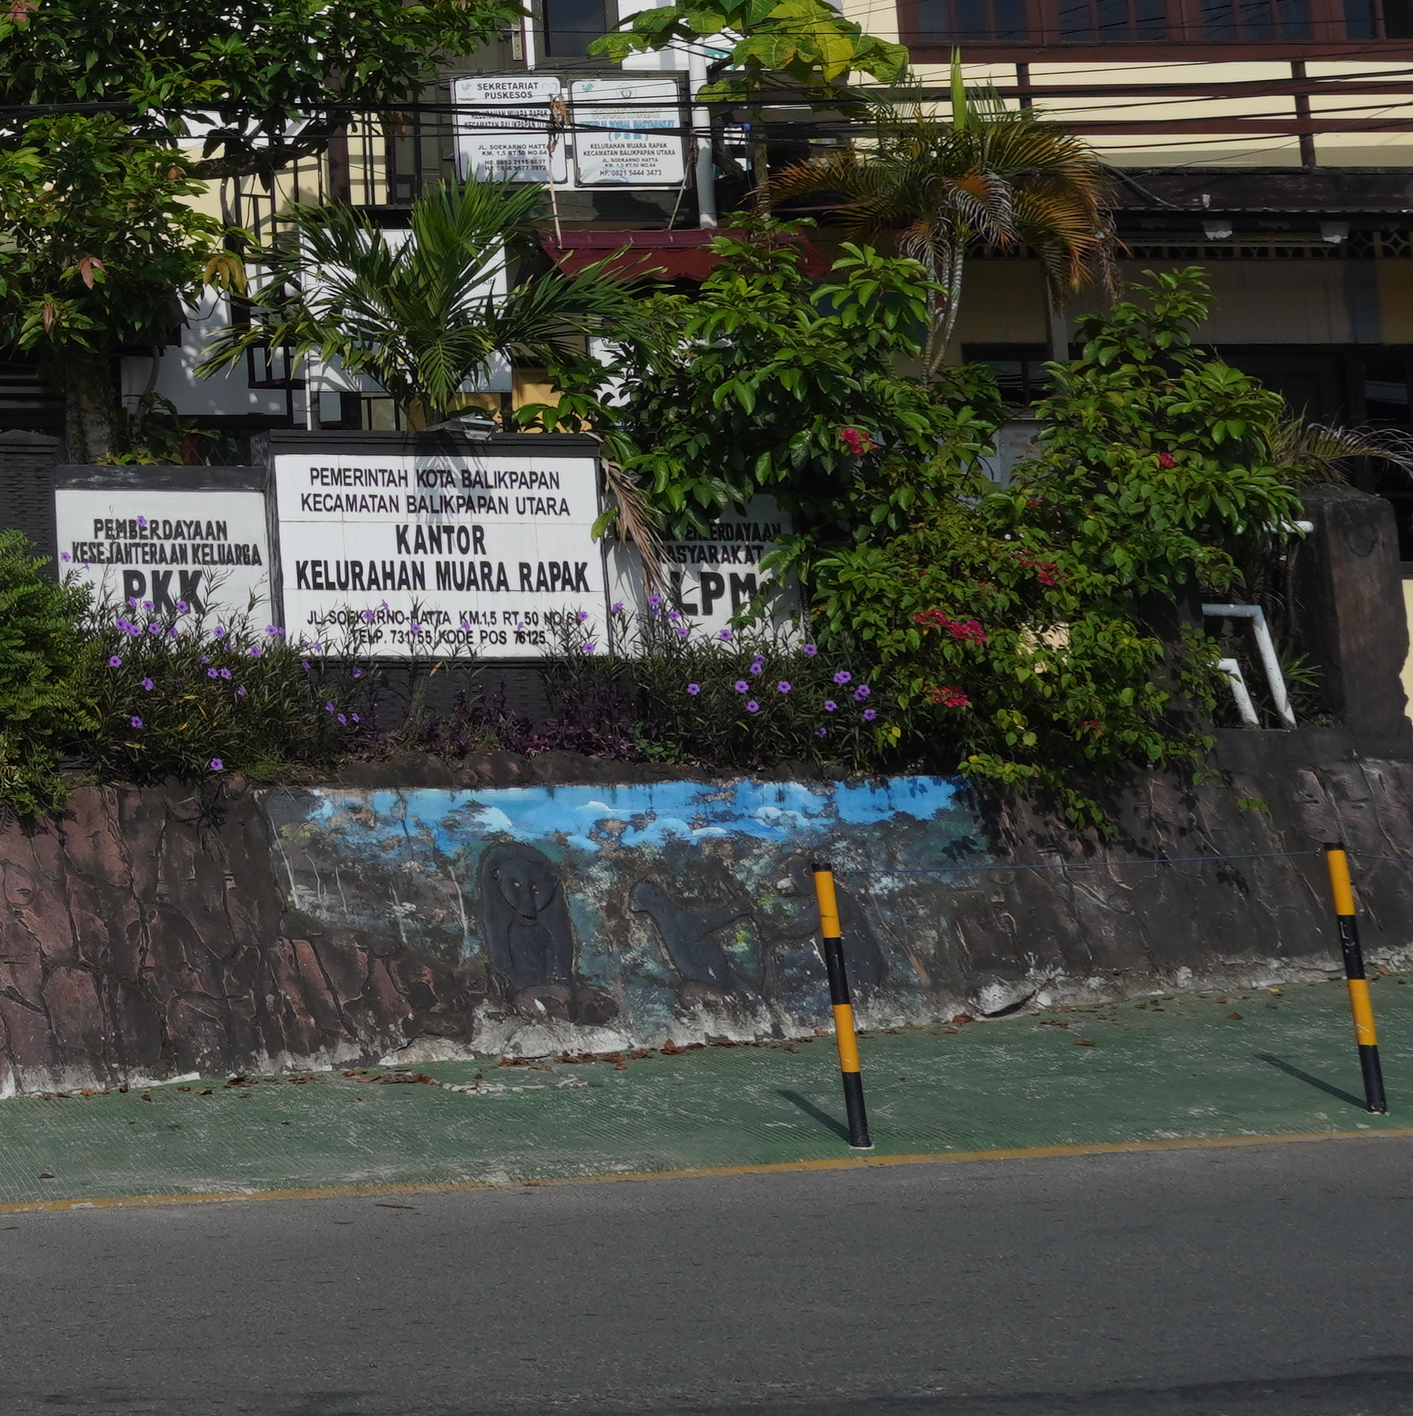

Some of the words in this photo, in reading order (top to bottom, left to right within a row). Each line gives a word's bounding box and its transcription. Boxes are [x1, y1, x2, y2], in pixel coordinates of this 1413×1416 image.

[477, 82, 539, 91] SEKRETARIAT
[484, 91, 533, 100] PUSKESOS
[309, 467, 409, 488] PEMERINTAH
[416, 469, 455, 489] KOTA
[461, 470, 560, 490] BALIKPAPAN
[301, 493, 399, 514] KECAMATAN
[407, 494, 509, 515] BALIKPAPAN
[515, 496, 571, 516] UTARA
[93, 518, 228, 541] PEMBERDAYAAN
[395, 524, 487, 555] KANTOR
[191, 543, 263, 566] KELUARGA
[295, 559, 425, 590] KELURAHAN
[435, 560, 510, 592] MUARA
[518, 561, 590, 592] RAPAK
[122, 569, 206, 615] PKK
[670, 571, 758, 616] LPM
[524, 611, 539, 626] 50
[438, 630, 474, 644] KODE
[480, 630, 507, 645] POS
[513, 630, 546, 645] 76125
